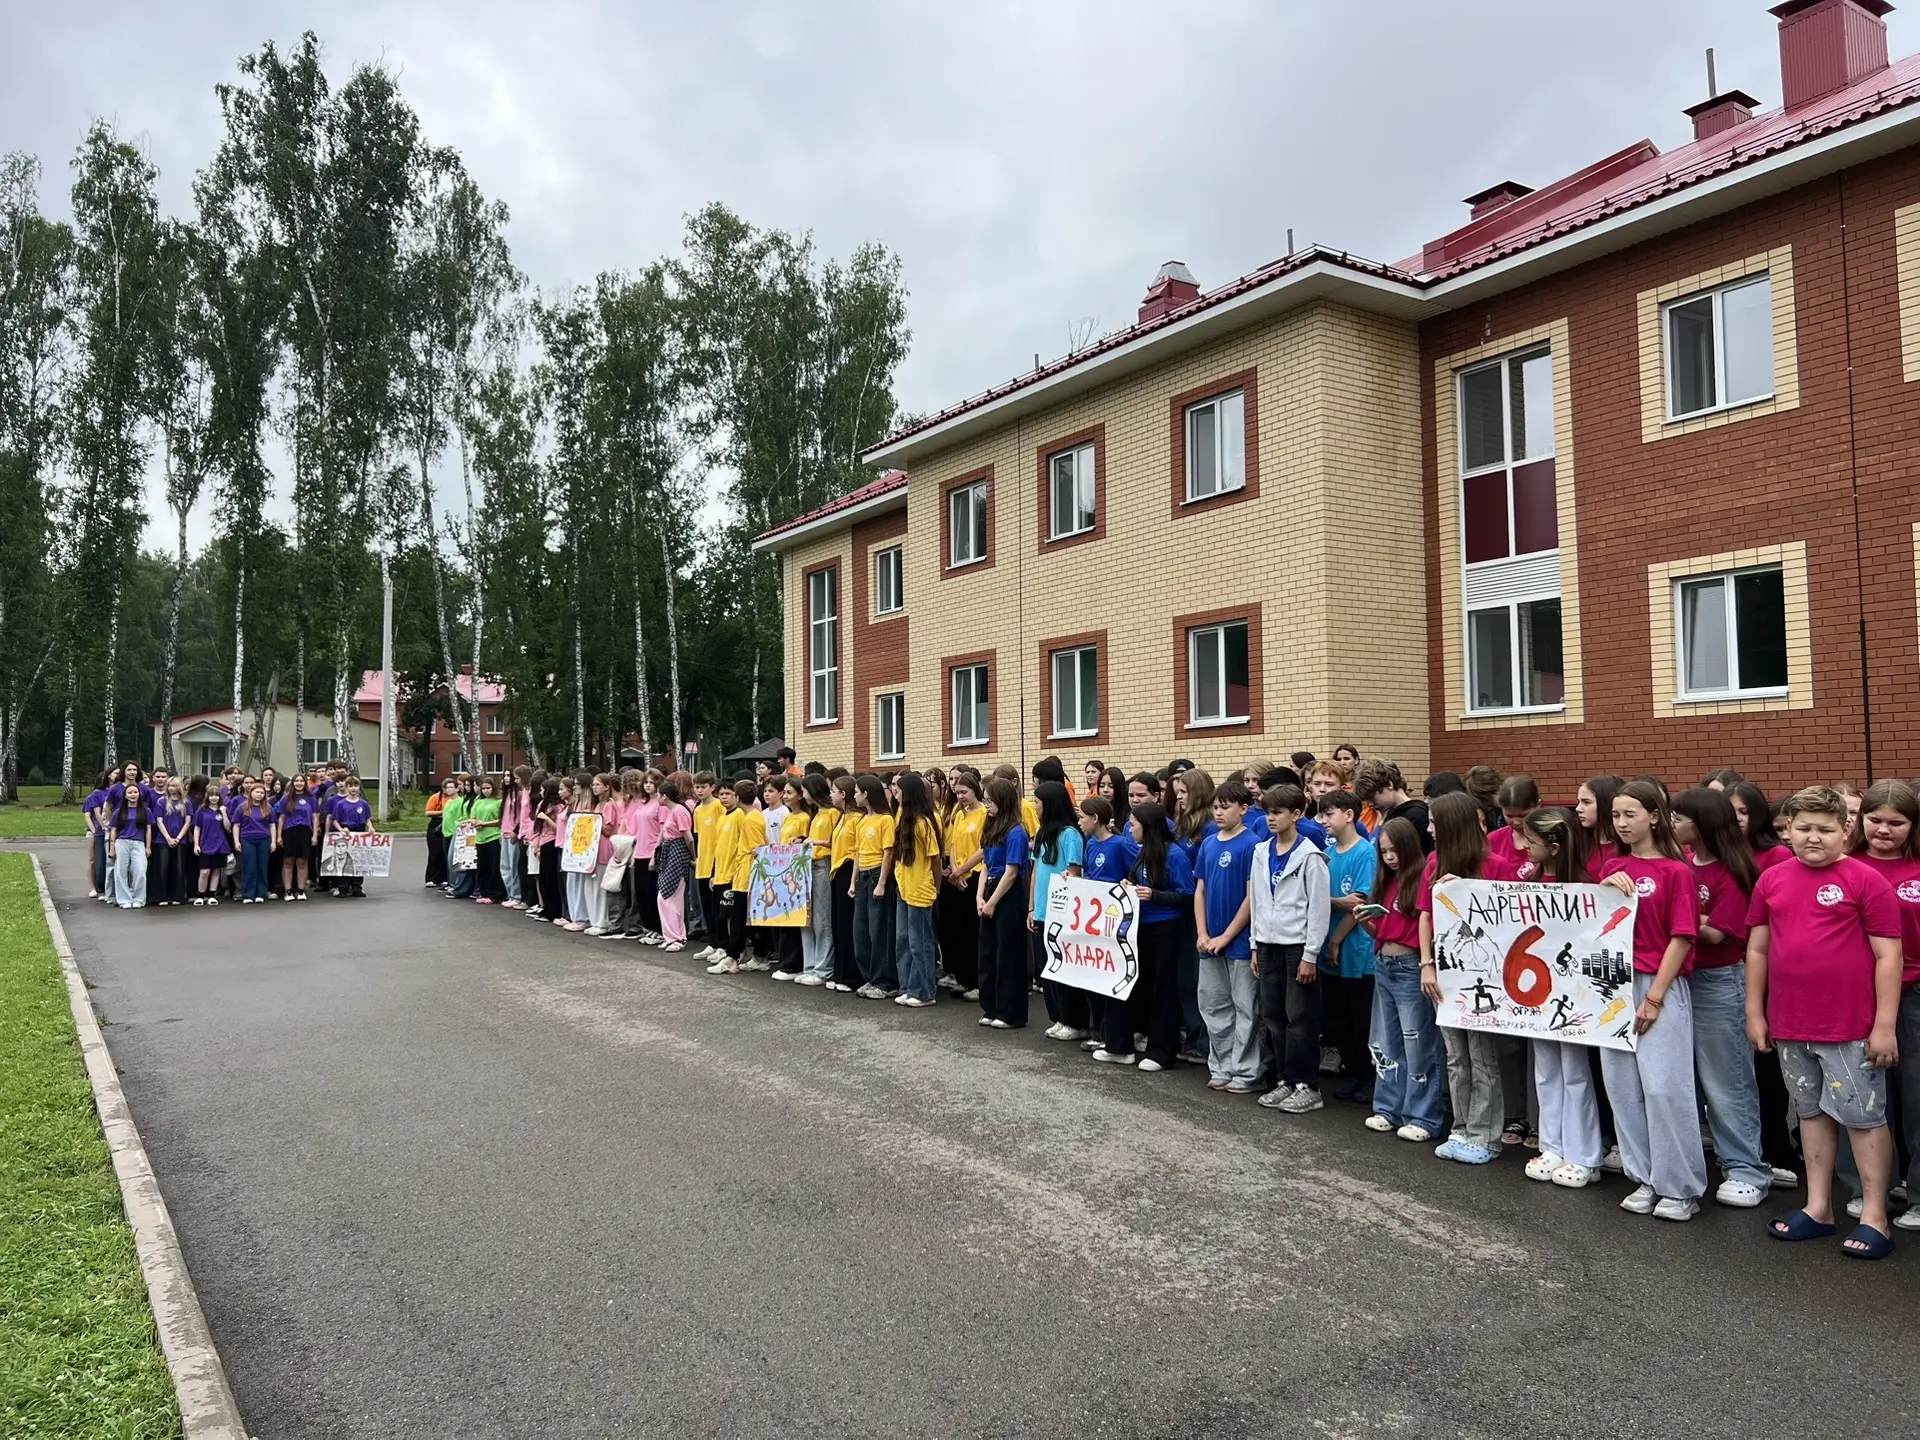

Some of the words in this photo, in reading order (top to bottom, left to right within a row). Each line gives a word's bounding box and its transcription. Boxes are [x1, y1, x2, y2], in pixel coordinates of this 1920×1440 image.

[1070, 896, 1103, 936] 32
[1468, 892, 1597, 926] АДРЕНАЛИН
[1061, 941, 1115, 972] КАДРА
[1503, 925, 1552, 1007] 6
